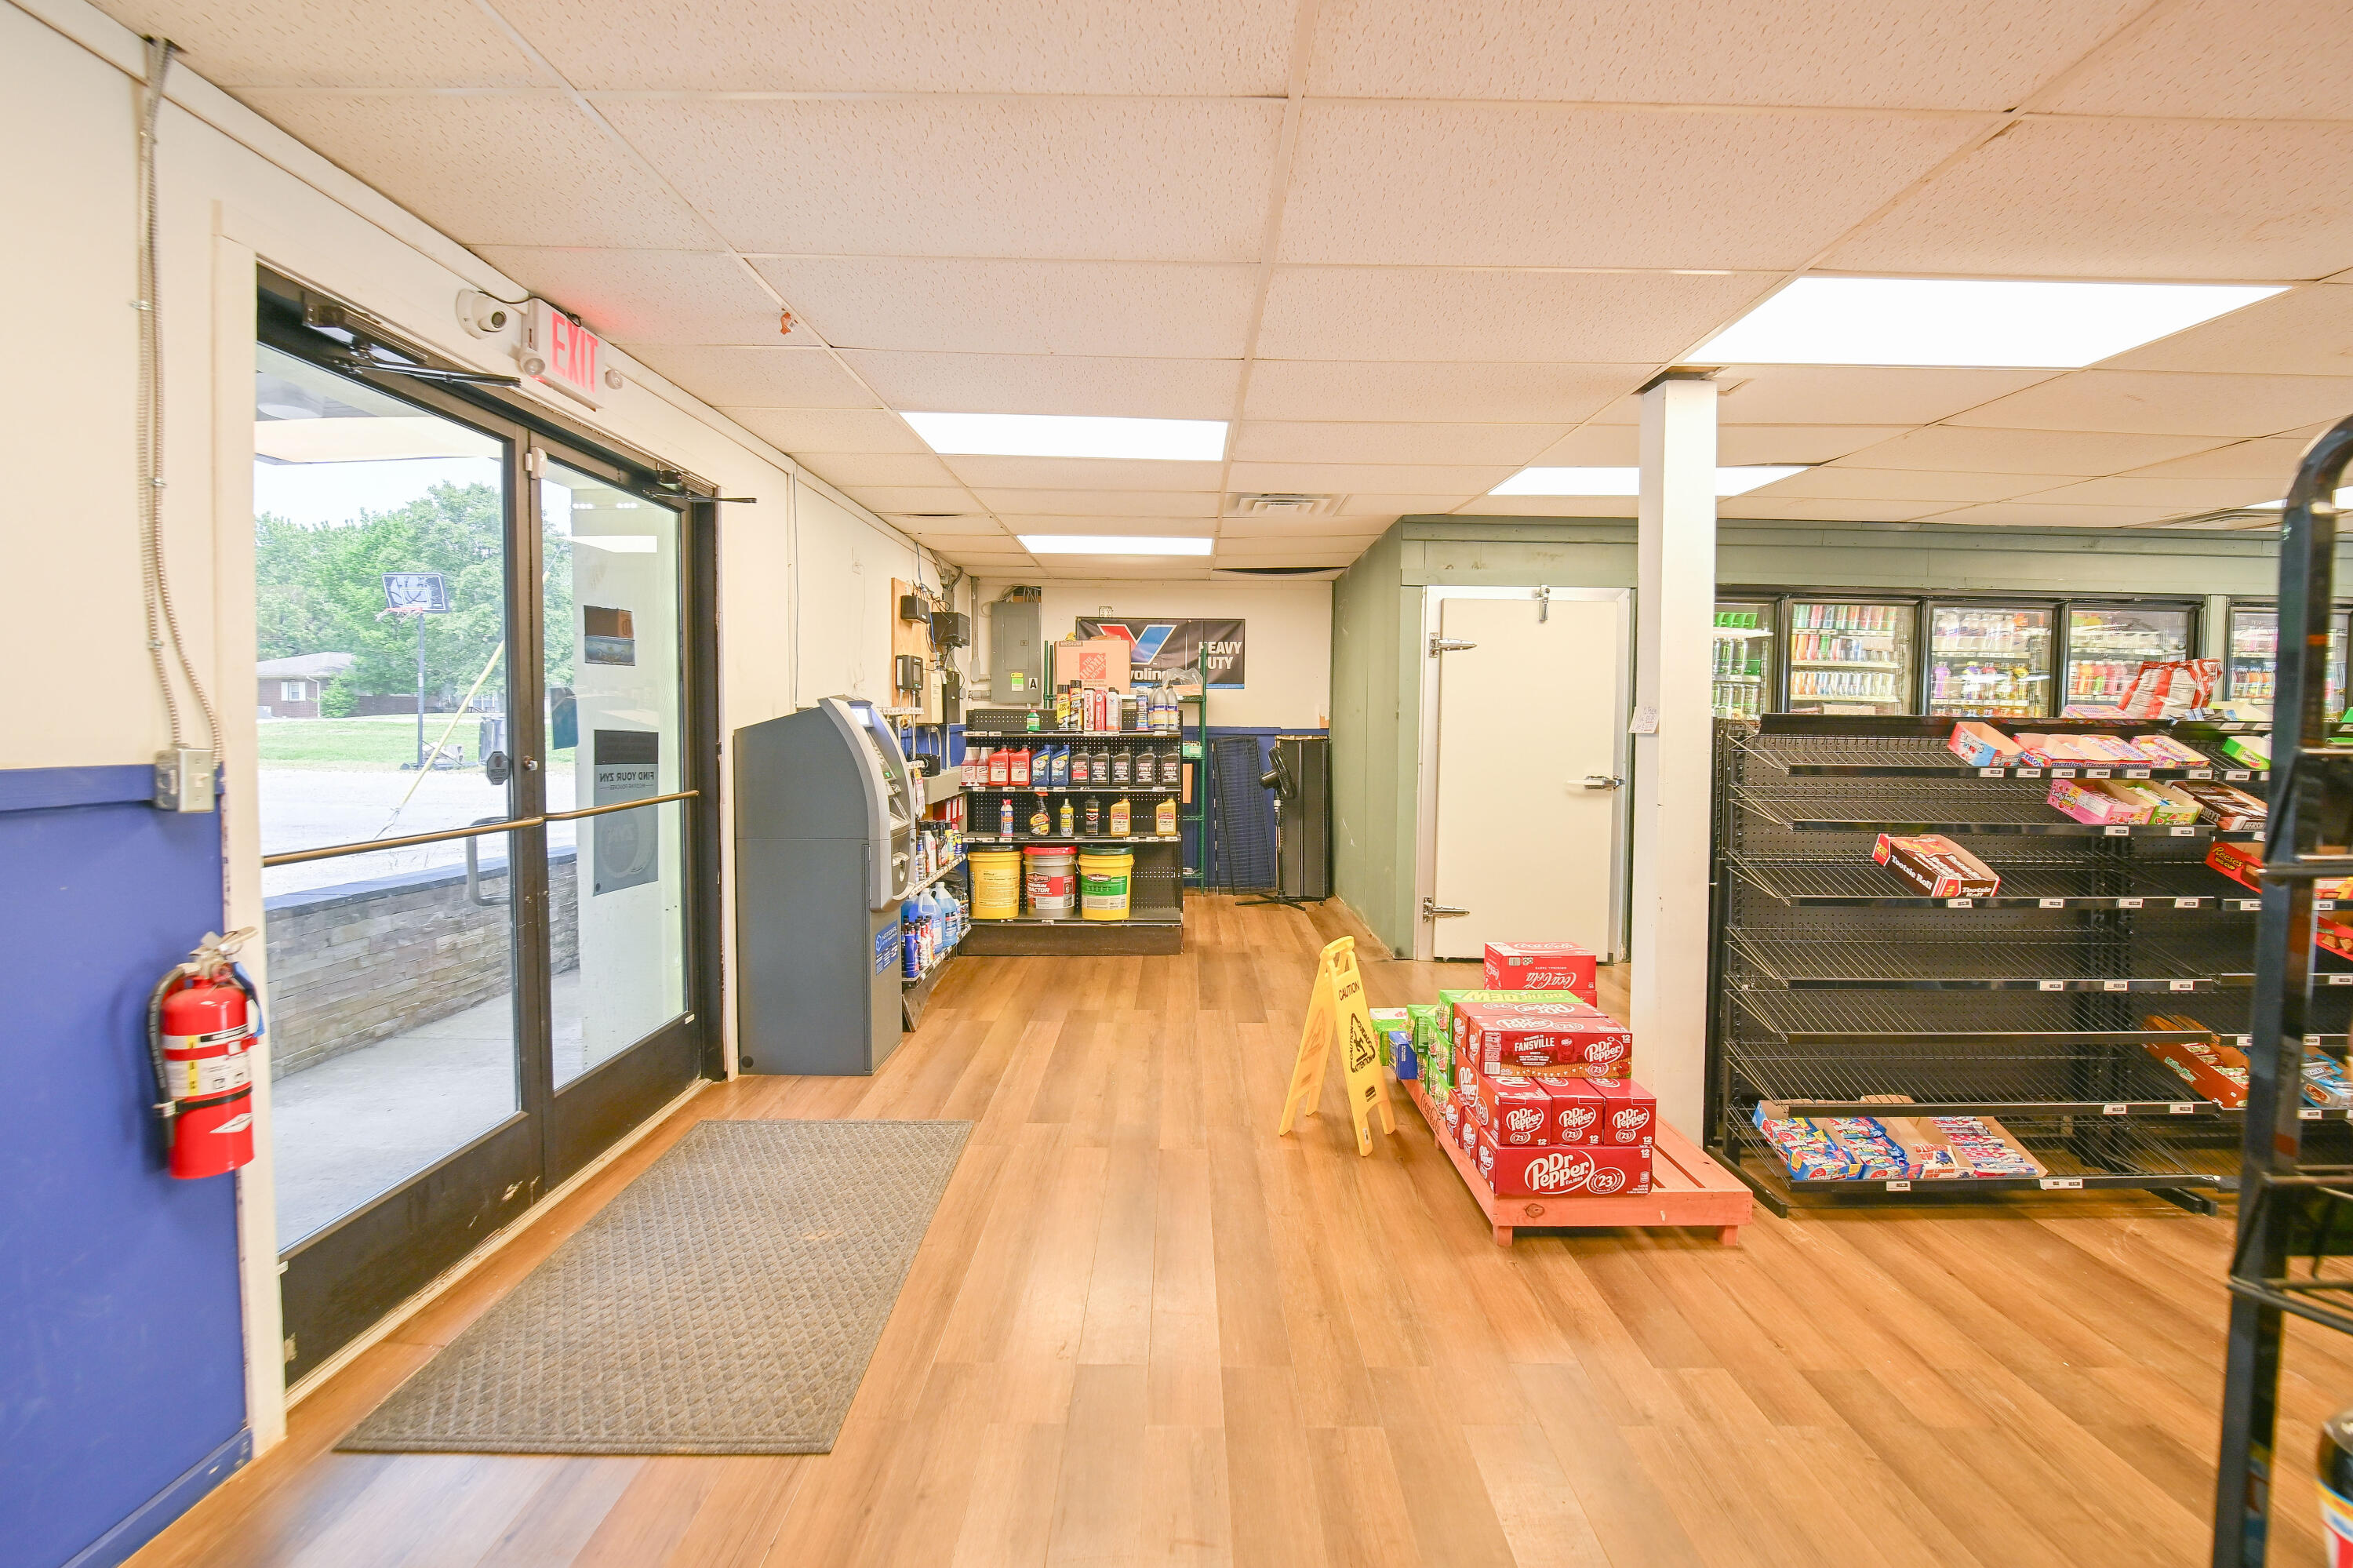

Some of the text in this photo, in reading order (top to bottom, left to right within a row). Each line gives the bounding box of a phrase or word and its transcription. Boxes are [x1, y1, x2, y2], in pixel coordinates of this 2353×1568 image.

[551, 311, 599, 394] EXIT
[1030, 678, 1037, 689] A
[2052, 789, 2077, 805] Laffy Taffy
[2213, 847, 2243, 867] Reese's
[1892, 855, 1916, 879] Tootsie
[1916, 874, 1933, 890] Roll
[1338, 980, 1360, 1001] CAUTION
[1462, 991, 1518, 1002] DEW
[1357, 1020, 1373, 1048] CUIDADO
[1515, 1037, 1555, 1052] FANSVILLE
[1585, 1044, 1621, 1062] Pepper
[1354, 1056, 1373, 1073] ATTENTION
[1507, 1110, 1542, 1131] Pepper
[1519, 1108, 1533, 1117] Dr
[1559, 1110, 1594, 1127] Pepper
[1572, 1108, 1585, 1116] Dr
[1613, 1111, 1647, 1129] Pepper
[1549, 1153, 1574, 1173] Dr
[1525, 1158, 1590, 1191] Pepper
[1598, 1175, 1613, 1187] 23
